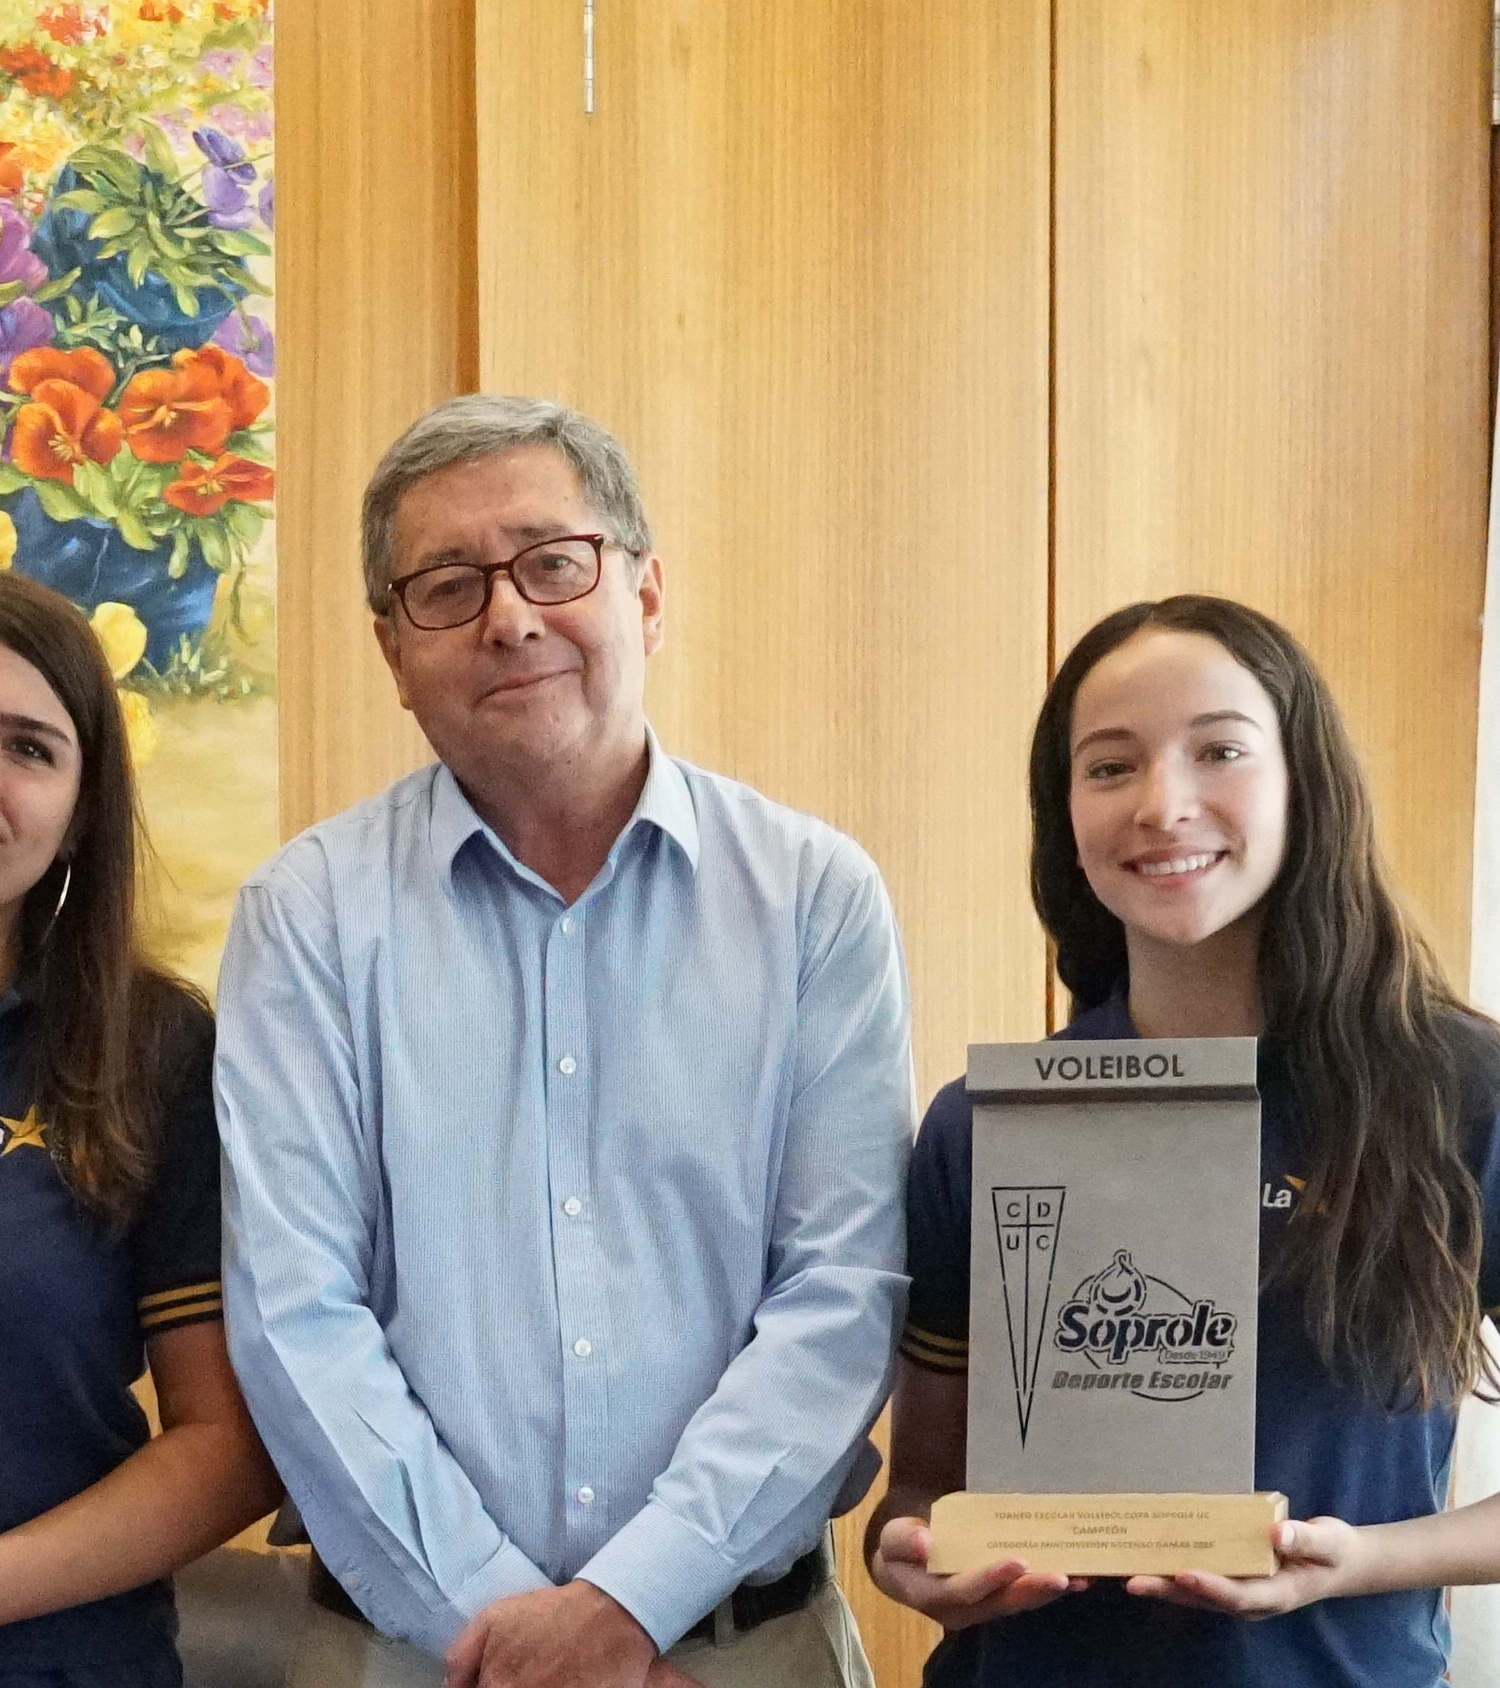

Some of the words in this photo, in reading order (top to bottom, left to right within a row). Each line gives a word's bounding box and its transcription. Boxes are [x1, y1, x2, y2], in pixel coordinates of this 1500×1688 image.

[1034, 1053, 1185, 1081] VOLEIBOL
[1262, 1183, 1292, 1208] La
[1006, 1202, 1021, 1218] C
[1037, 1202, 1051, 1218] D
[1006, 1234, 1019, 1251] U
[1036, 1234, 1050, 1250] C
[1058, 1303, 1233, 1361] Soprole
[1051, 1370, 1145, 1391] Deporte
[1147, 1370, 1234, 1390] Escolar
